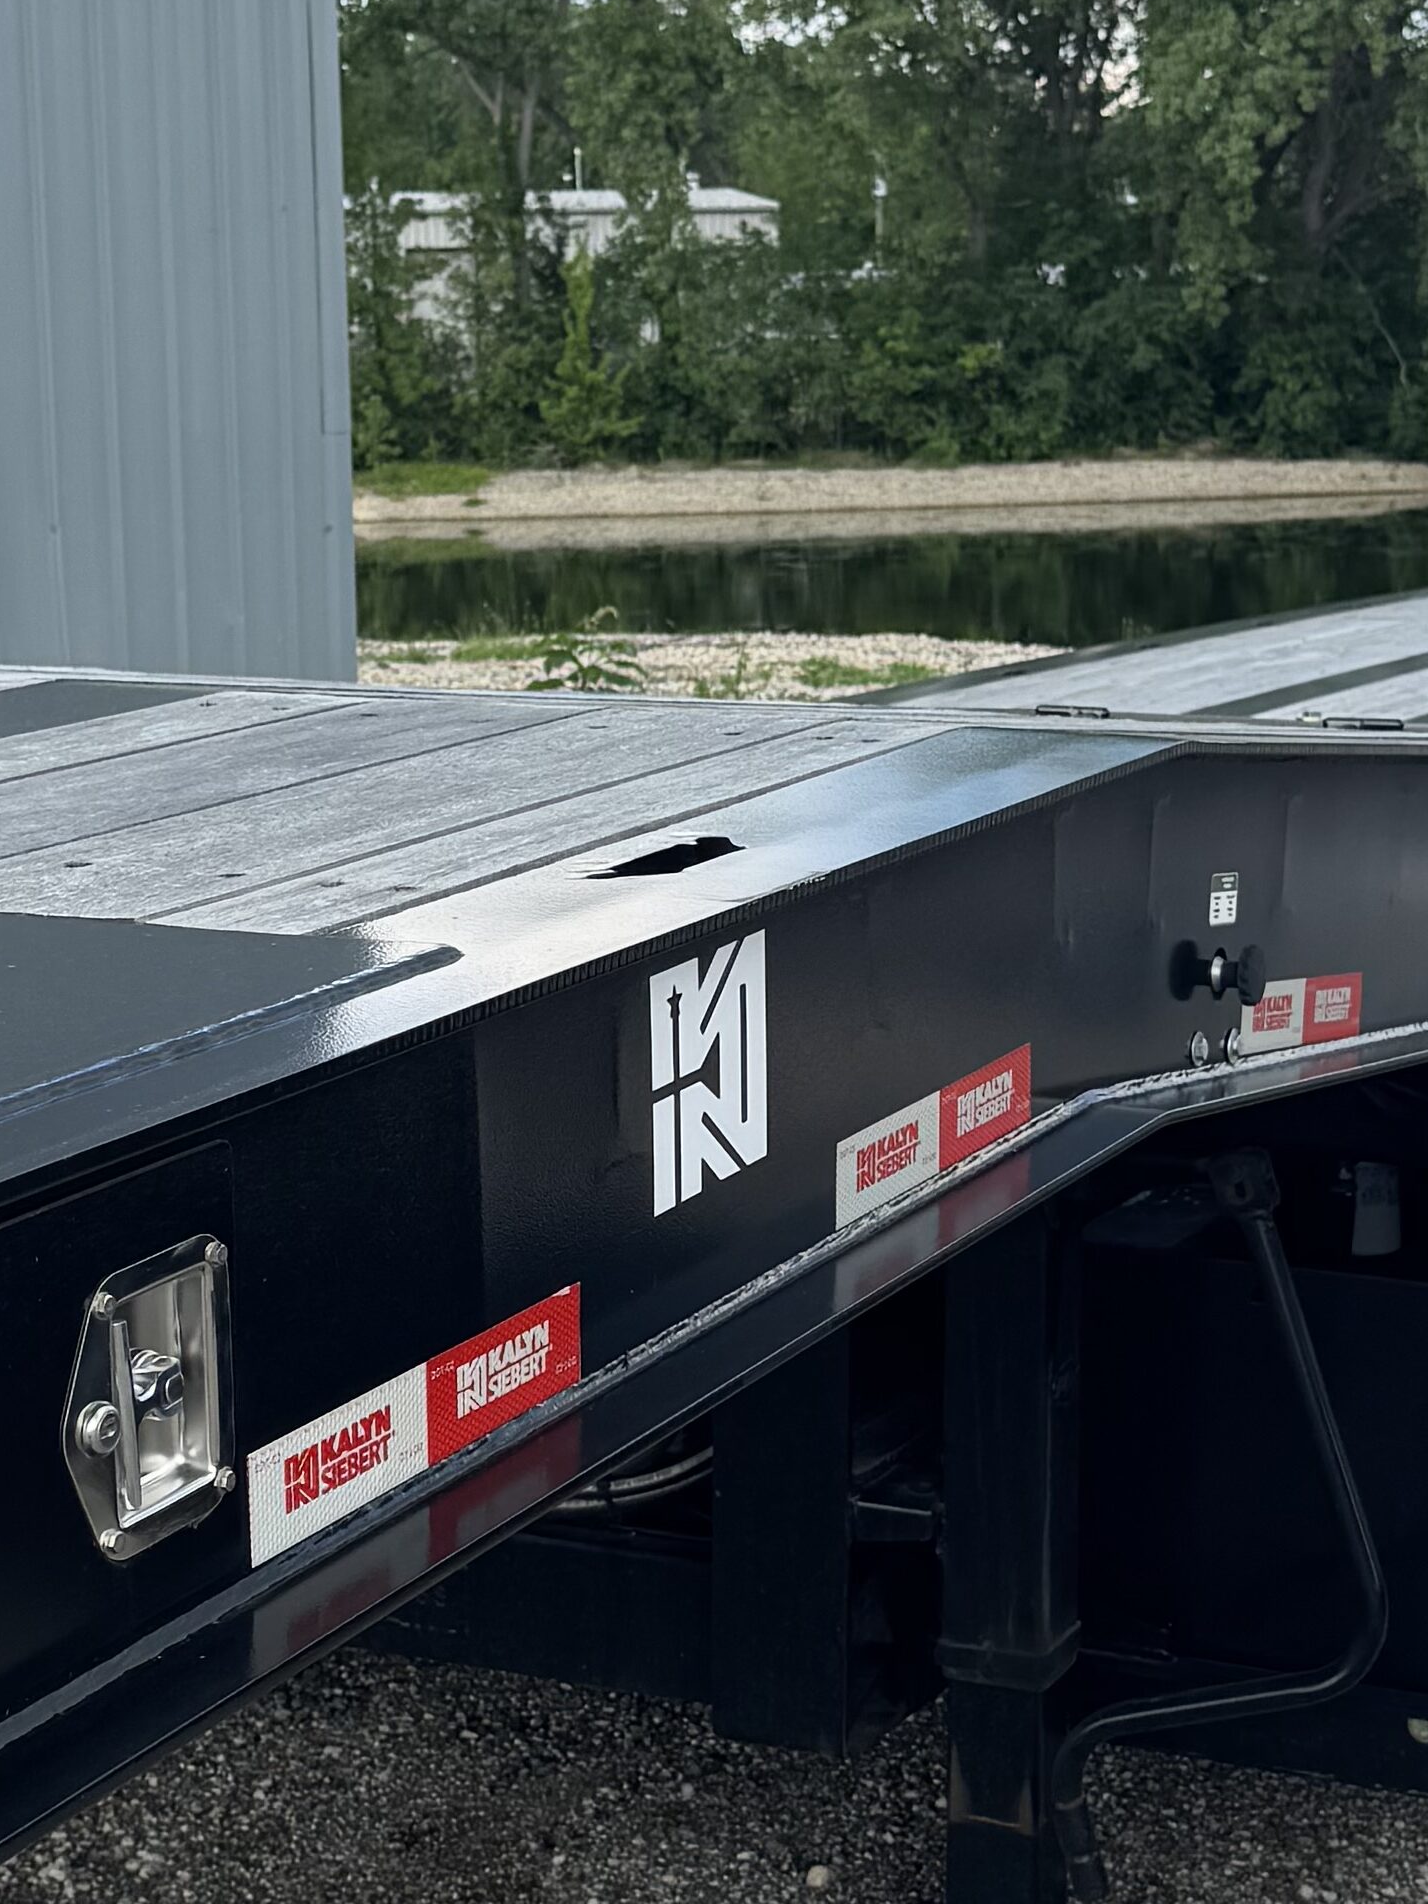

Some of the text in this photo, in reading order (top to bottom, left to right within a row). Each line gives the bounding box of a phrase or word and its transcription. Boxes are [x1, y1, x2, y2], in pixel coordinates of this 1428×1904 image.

[976, 1068, 1013, 1107] KALYN
[877, 1120, 918, 1160] KALYN
[487, 1346, 549, 1404] SIEBERT
[488, 1319, 549, 1376] KALYN
[321, 1405, 391, 1465] KALYN
[321, 1433, 392, 1495] SIEBERT
